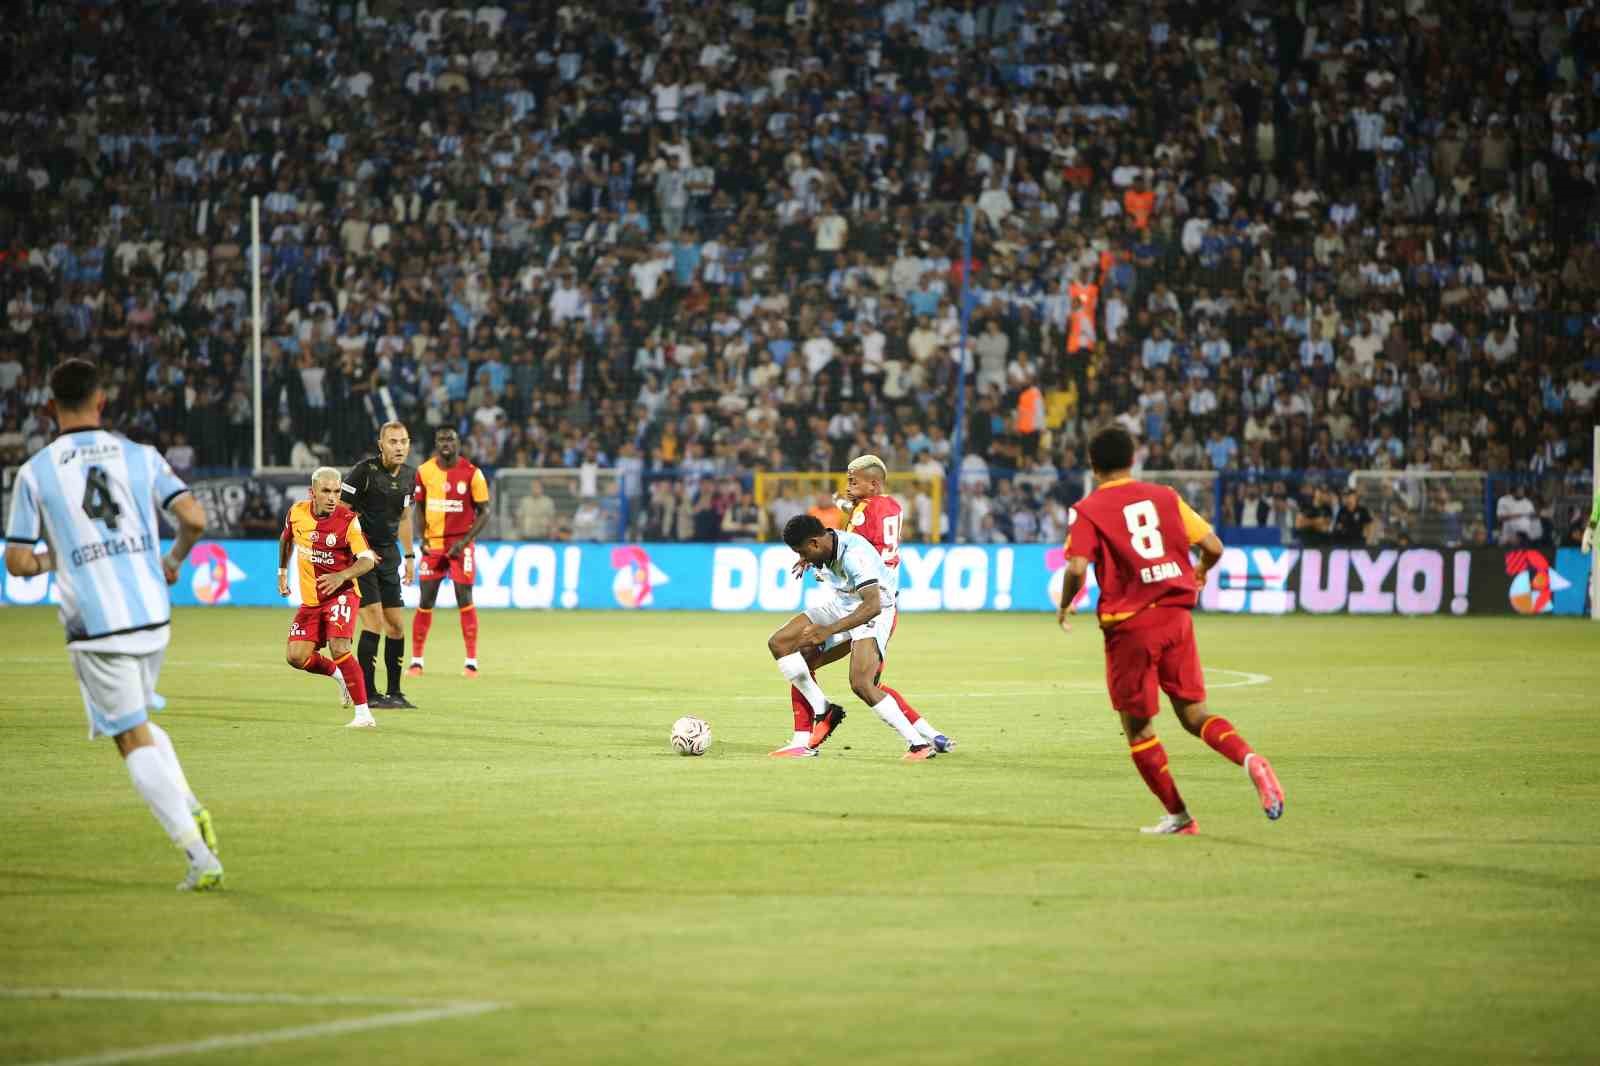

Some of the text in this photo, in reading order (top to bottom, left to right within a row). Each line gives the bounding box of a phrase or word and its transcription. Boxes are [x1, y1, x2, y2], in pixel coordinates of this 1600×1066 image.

[82, 466, 120, 529] 4
[1123, 499, 1165, 560] 8
[329, 604, 352, 624] 34
